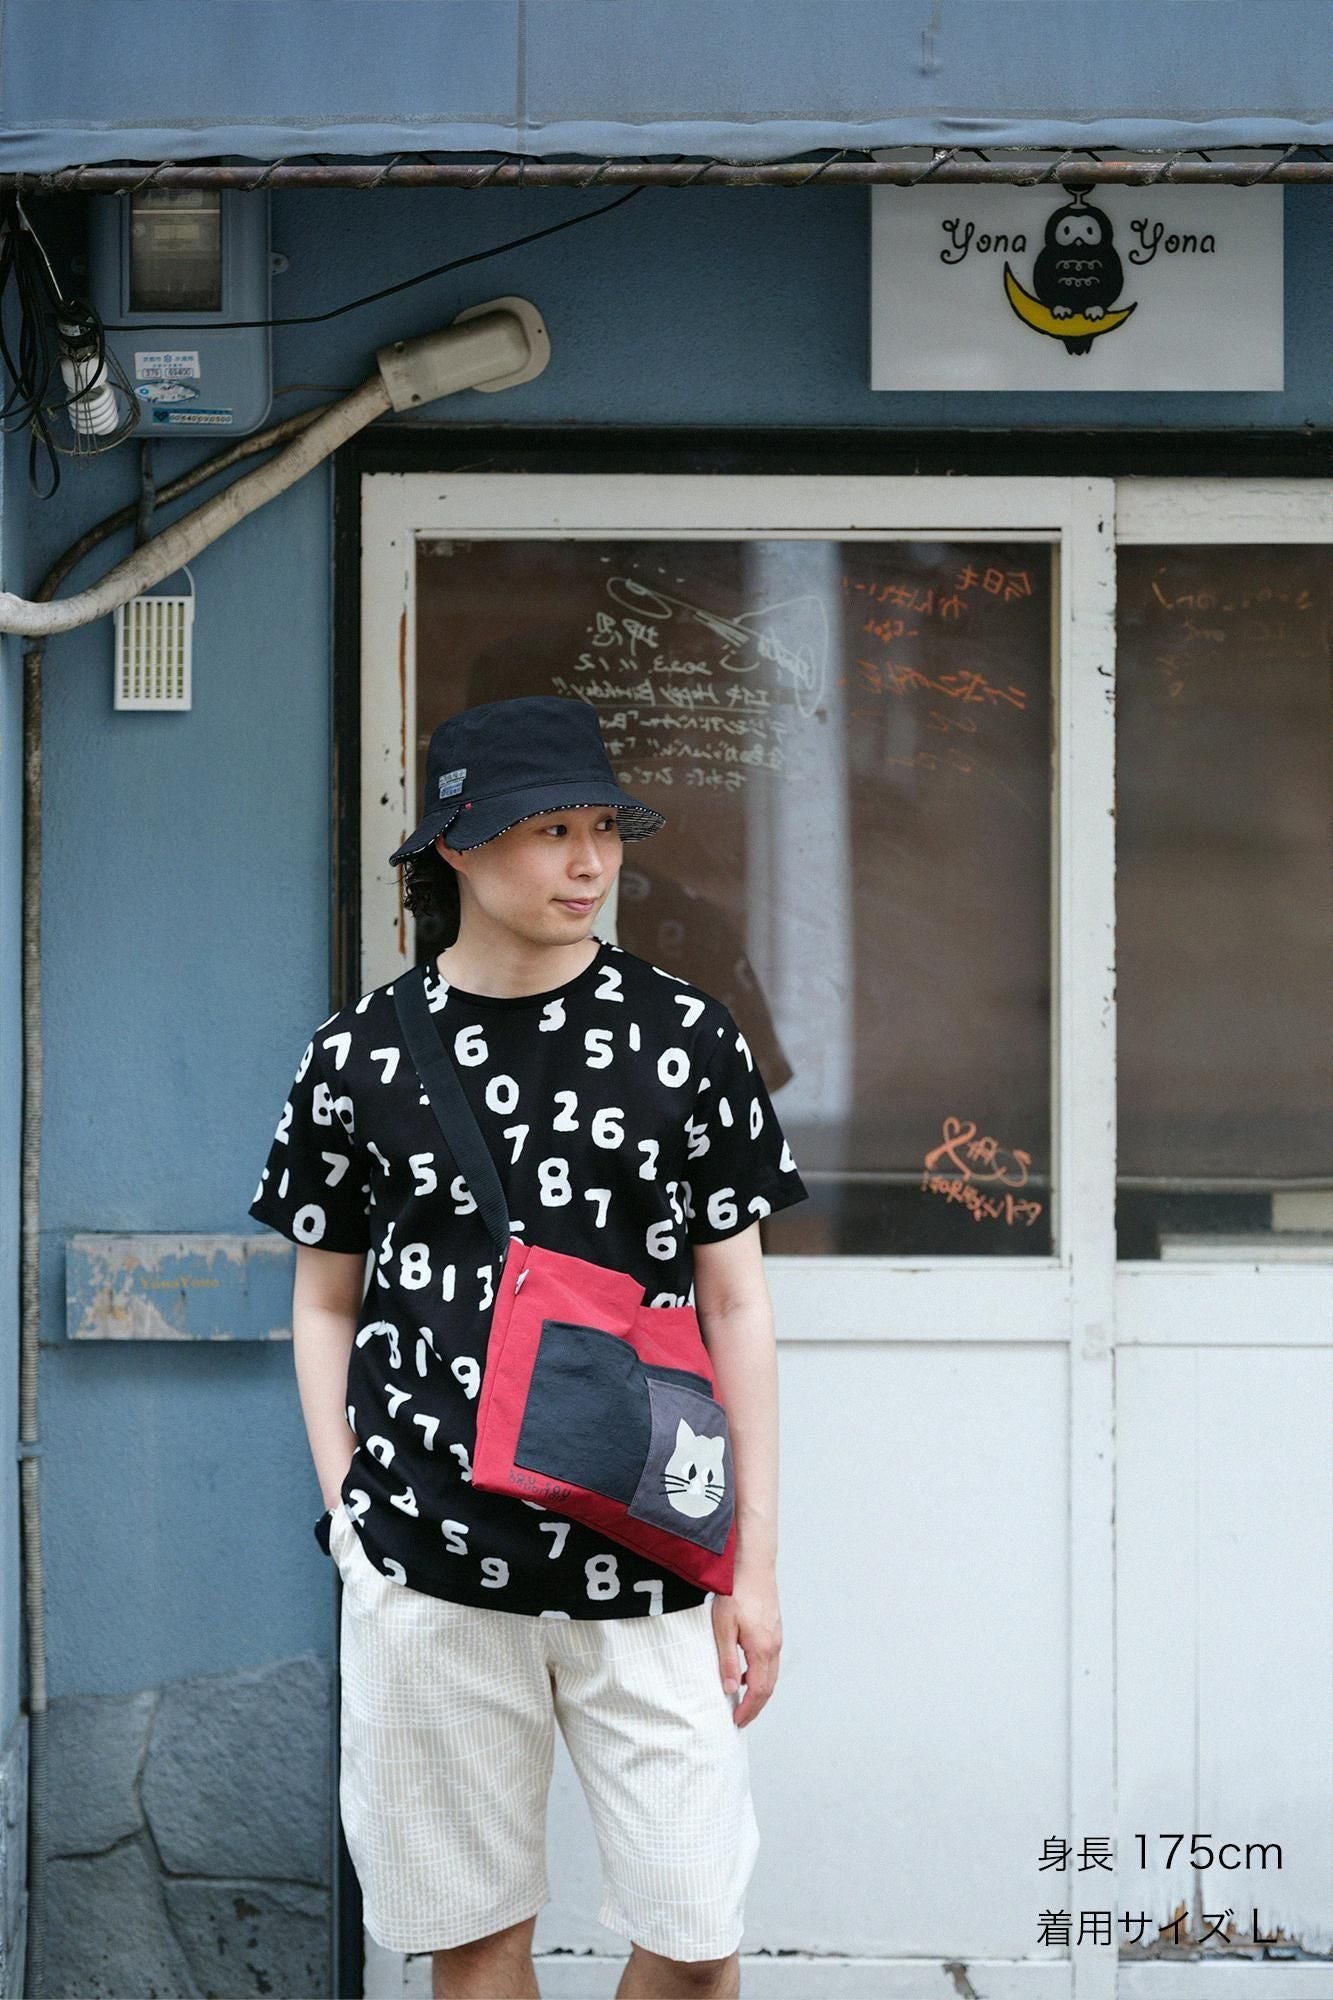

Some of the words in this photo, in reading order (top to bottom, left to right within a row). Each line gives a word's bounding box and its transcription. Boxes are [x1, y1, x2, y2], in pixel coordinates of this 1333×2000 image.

[940, 218, 1027, 265] Yona
[1128, 218, 1216, 265] Yona
[595, 966, 624, 1002] 2
[675, 995, 705, 1027] 7
[322, 1032, 351, 1070] 7
[370, 1047, 400, 1084] 7
[454, 1025, 489, 1067] 6
[585, 1029, 613, 1069] 5
[657, 1048, 690, 1088] 0
[485, 1075, 520, 1114] 0
[553, 1091, 579, 1132] 2
[503, 1125, 529, 1164] 7
[592, 1107, 625, 1149] 6
[322, 1152, 349, 1187] 7
[409, 1152, 437, 1196] 5
[538, 1158, 572, 1207] 8
[293, 1204, 326, 1245] 0
[584, 1189, 612, 1228] 7
[707, 1188, 738, 1230] 6
[646, 1219, 677, 1260] 6
[400, 1243, 432, 1290] 8
[451, 1356, 481, 1400] 9
[412, 1414, 440, 1450] 7
[539, 1522, 570, 1559] 7
[480, 1557, 509, 1589] 9
[585, 1554, 620, 1600] 8
